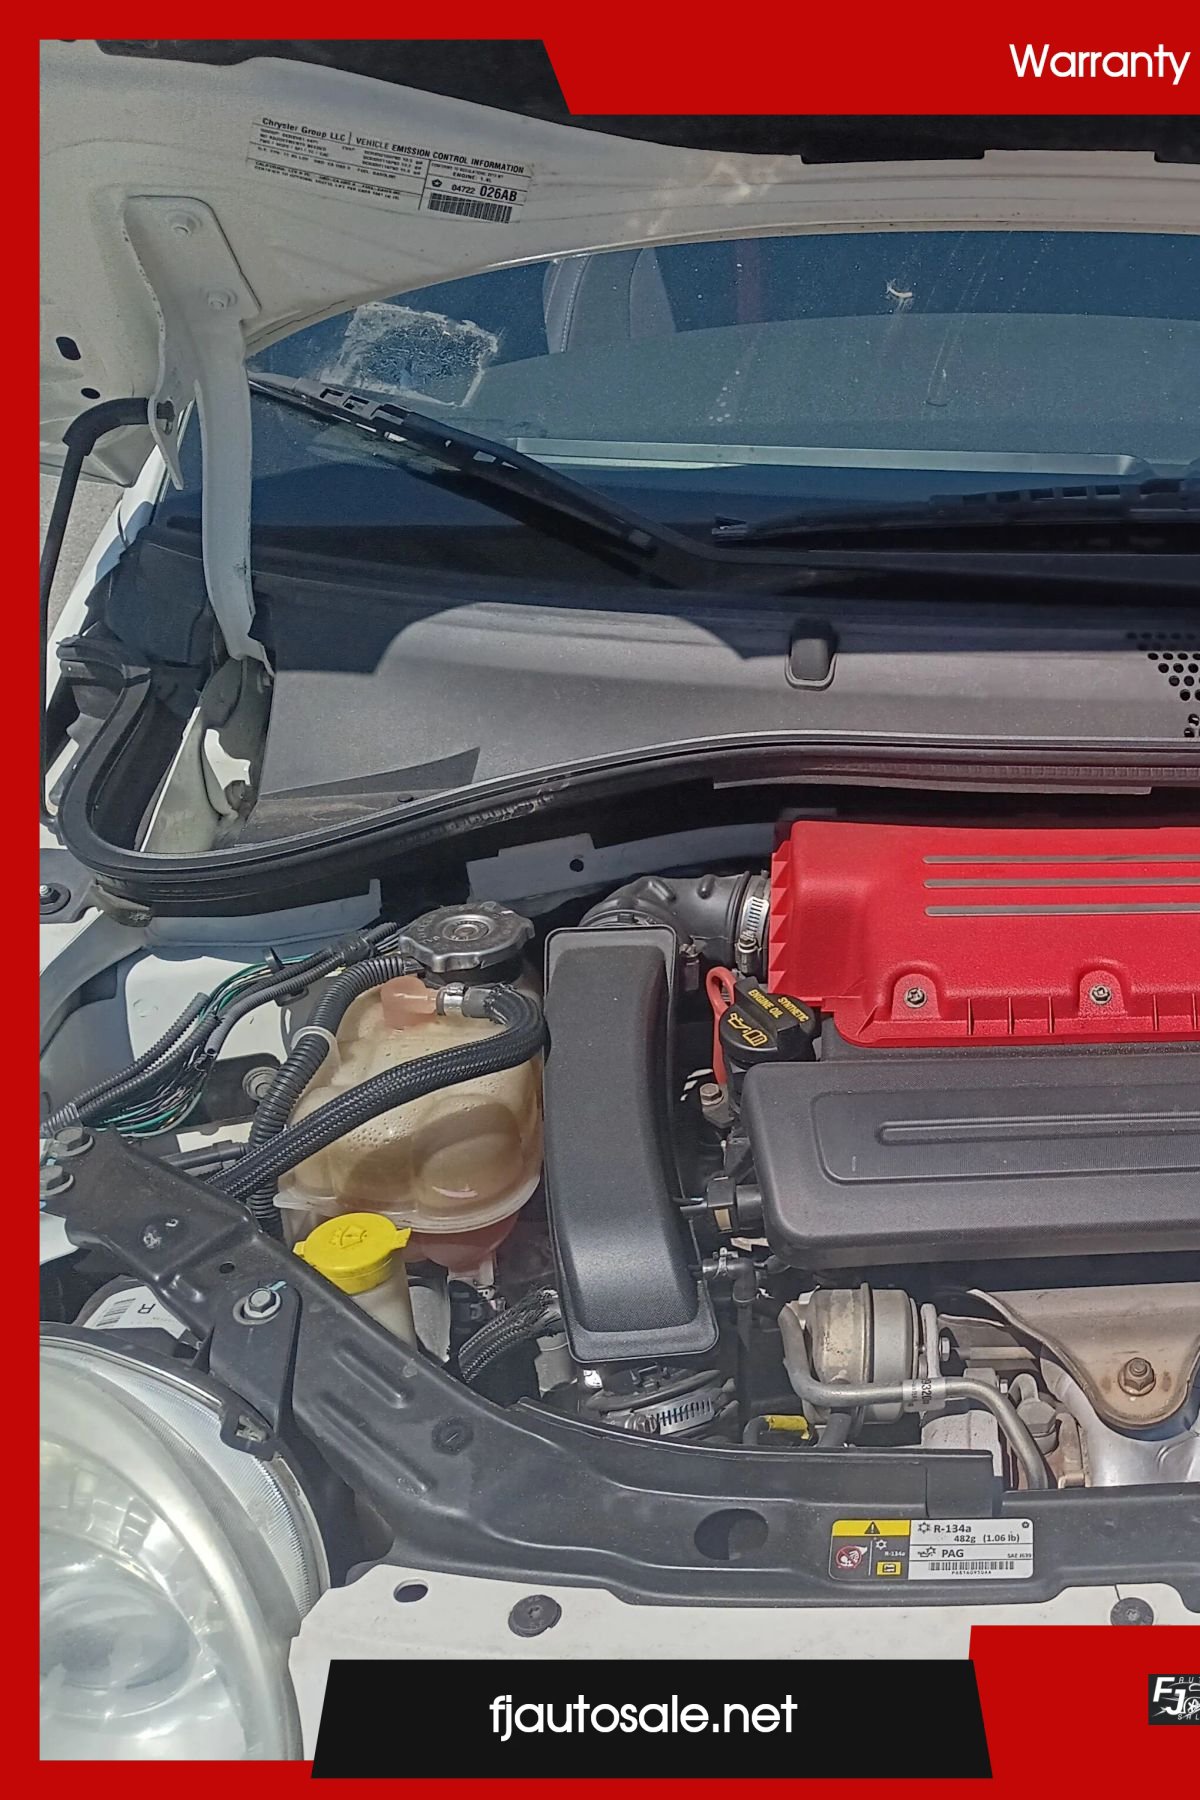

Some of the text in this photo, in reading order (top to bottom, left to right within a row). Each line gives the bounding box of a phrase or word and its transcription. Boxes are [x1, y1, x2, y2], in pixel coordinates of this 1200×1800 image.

[262, 117, 346, 142] Chrysler Group LLC
[355, 137, 390, 150] VEHICLE
[391, 143, 431, 158] EMISSION
[432, 151, 469, 165] CONTROL
[470, 159, 524, 174] INFORMATION
[479, 186, 517, 202] 026AB
[748, 989, 784, 1019] ENGINE OIL
[778, 997, 809, 1022] SYNTHETIC
[934, 1524, 972, 1534] R-134a
[954, 1534, 1020, 1543] 482g (1.06 lb)
[942, 1549, 964, 1558] PAG
